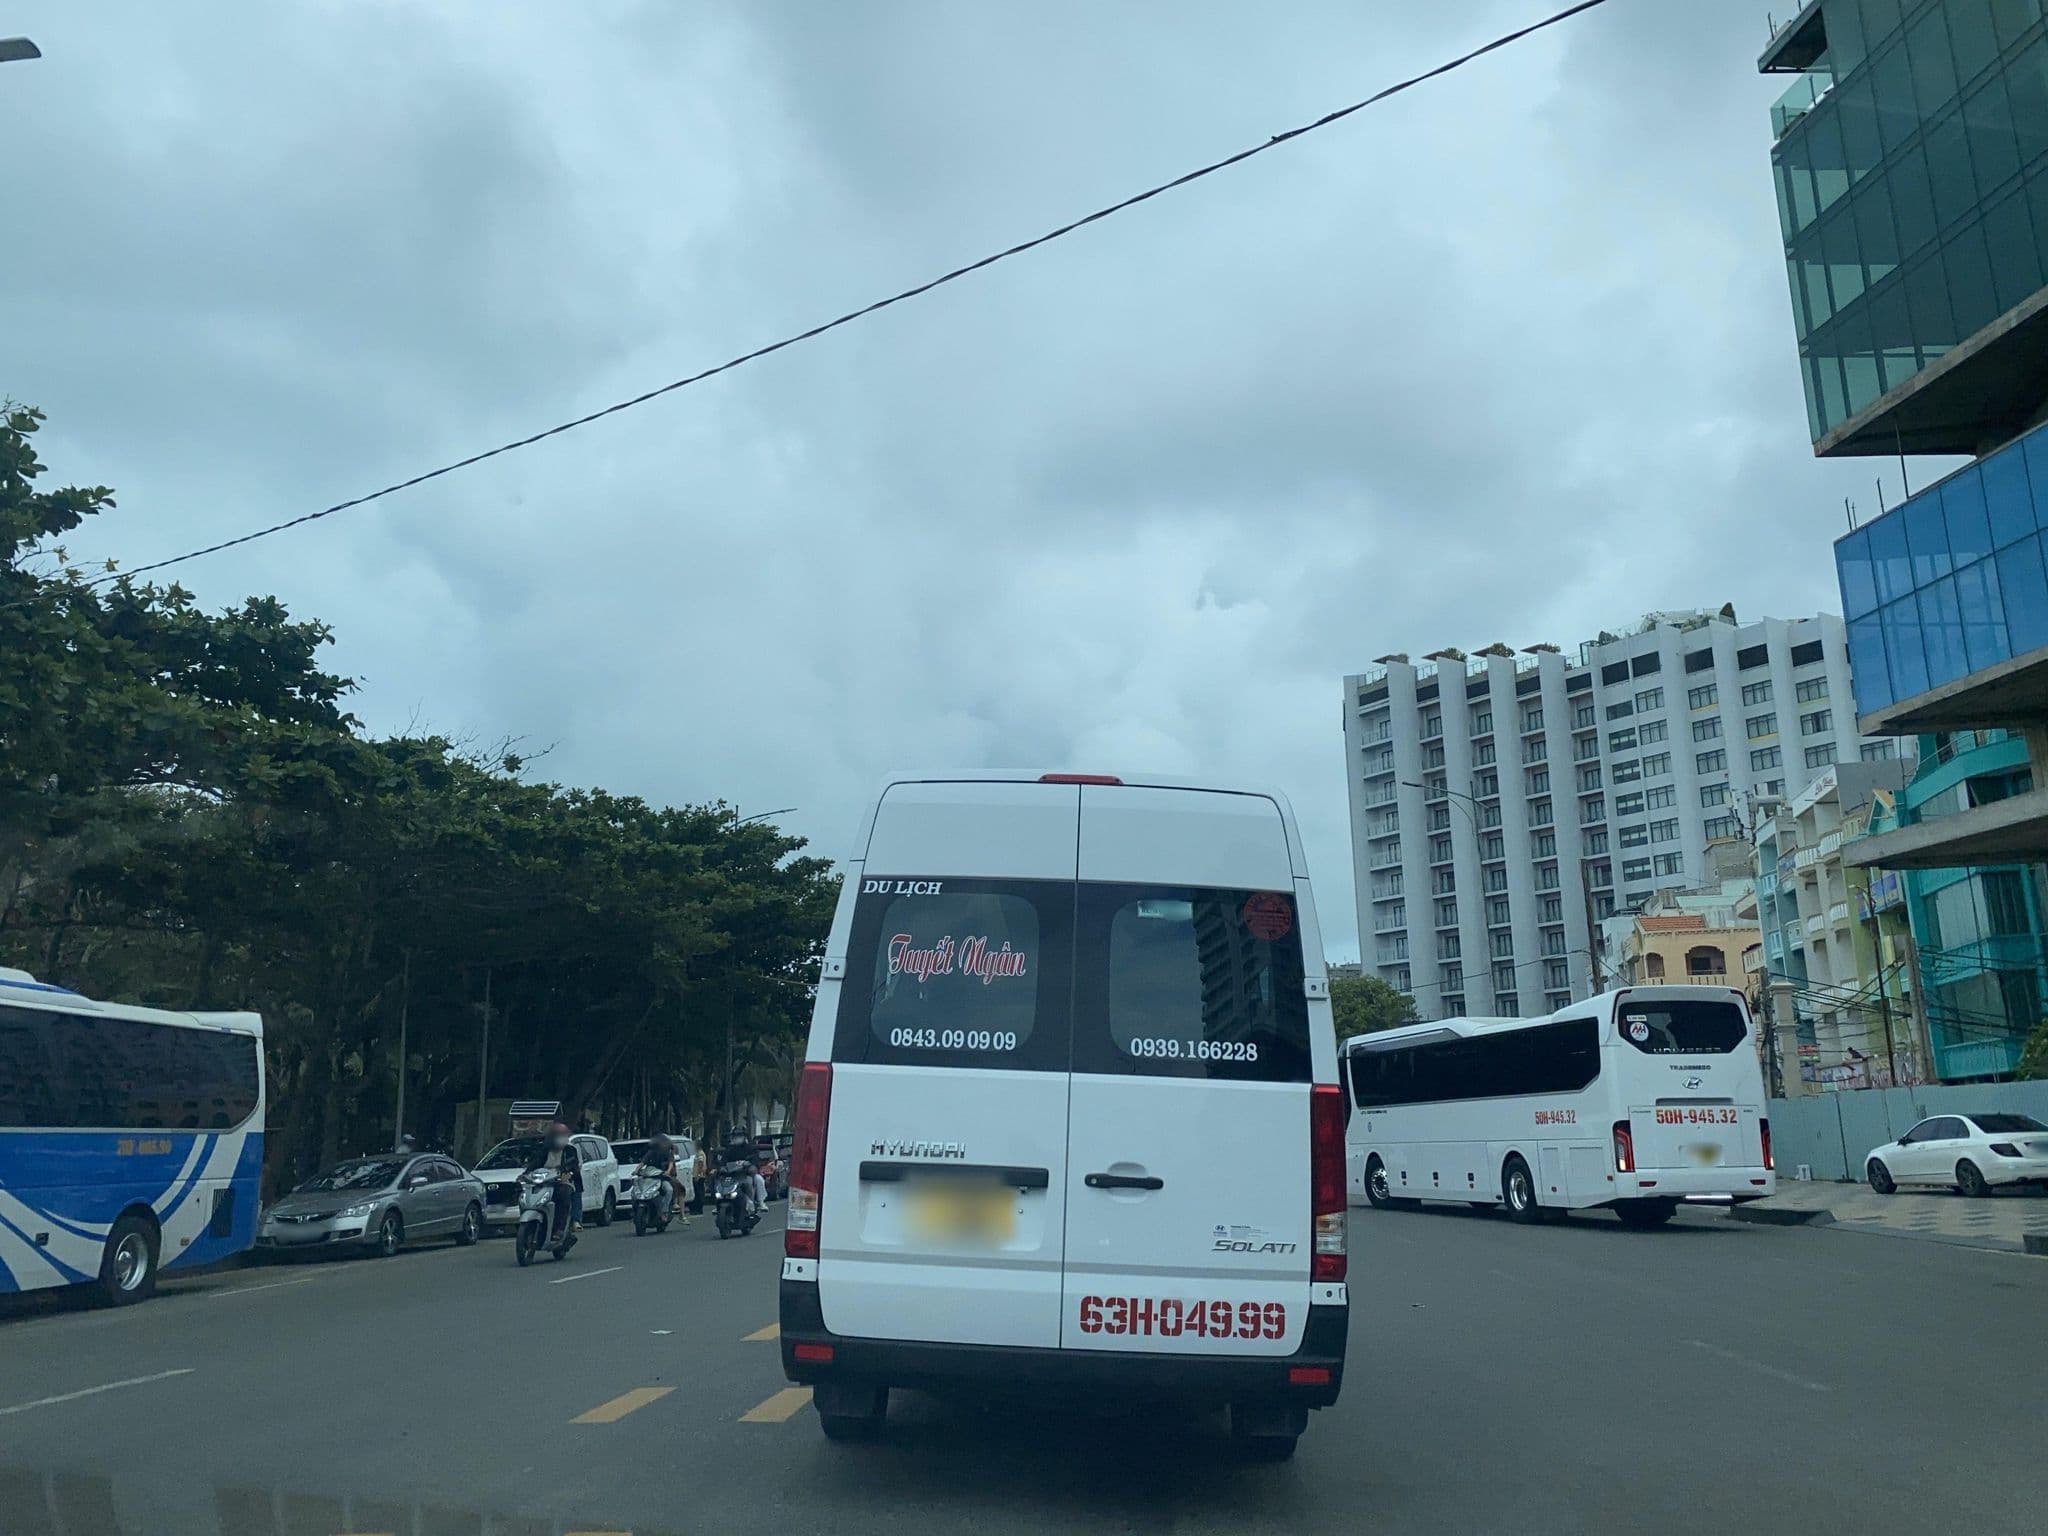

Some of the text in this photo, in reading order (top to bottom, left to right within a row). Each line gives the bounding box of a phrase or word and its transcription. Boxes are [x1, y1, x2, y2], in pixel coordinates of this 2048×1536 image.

[863, 880, 943, 897] DU LỊCH
[887, 933, 1027, 985] Tuyết Ngân
[1130, 1037, 1258, 1062] 0939.166228
[1534, 1109, 1577, 1125] 50H-945.32
[1655, 1108, 1738, 1124] 50H-945.32
[870, 1139, 966, 1159] HYUNDAI
[1211, 1239, 1297, 1254] SOLATI
